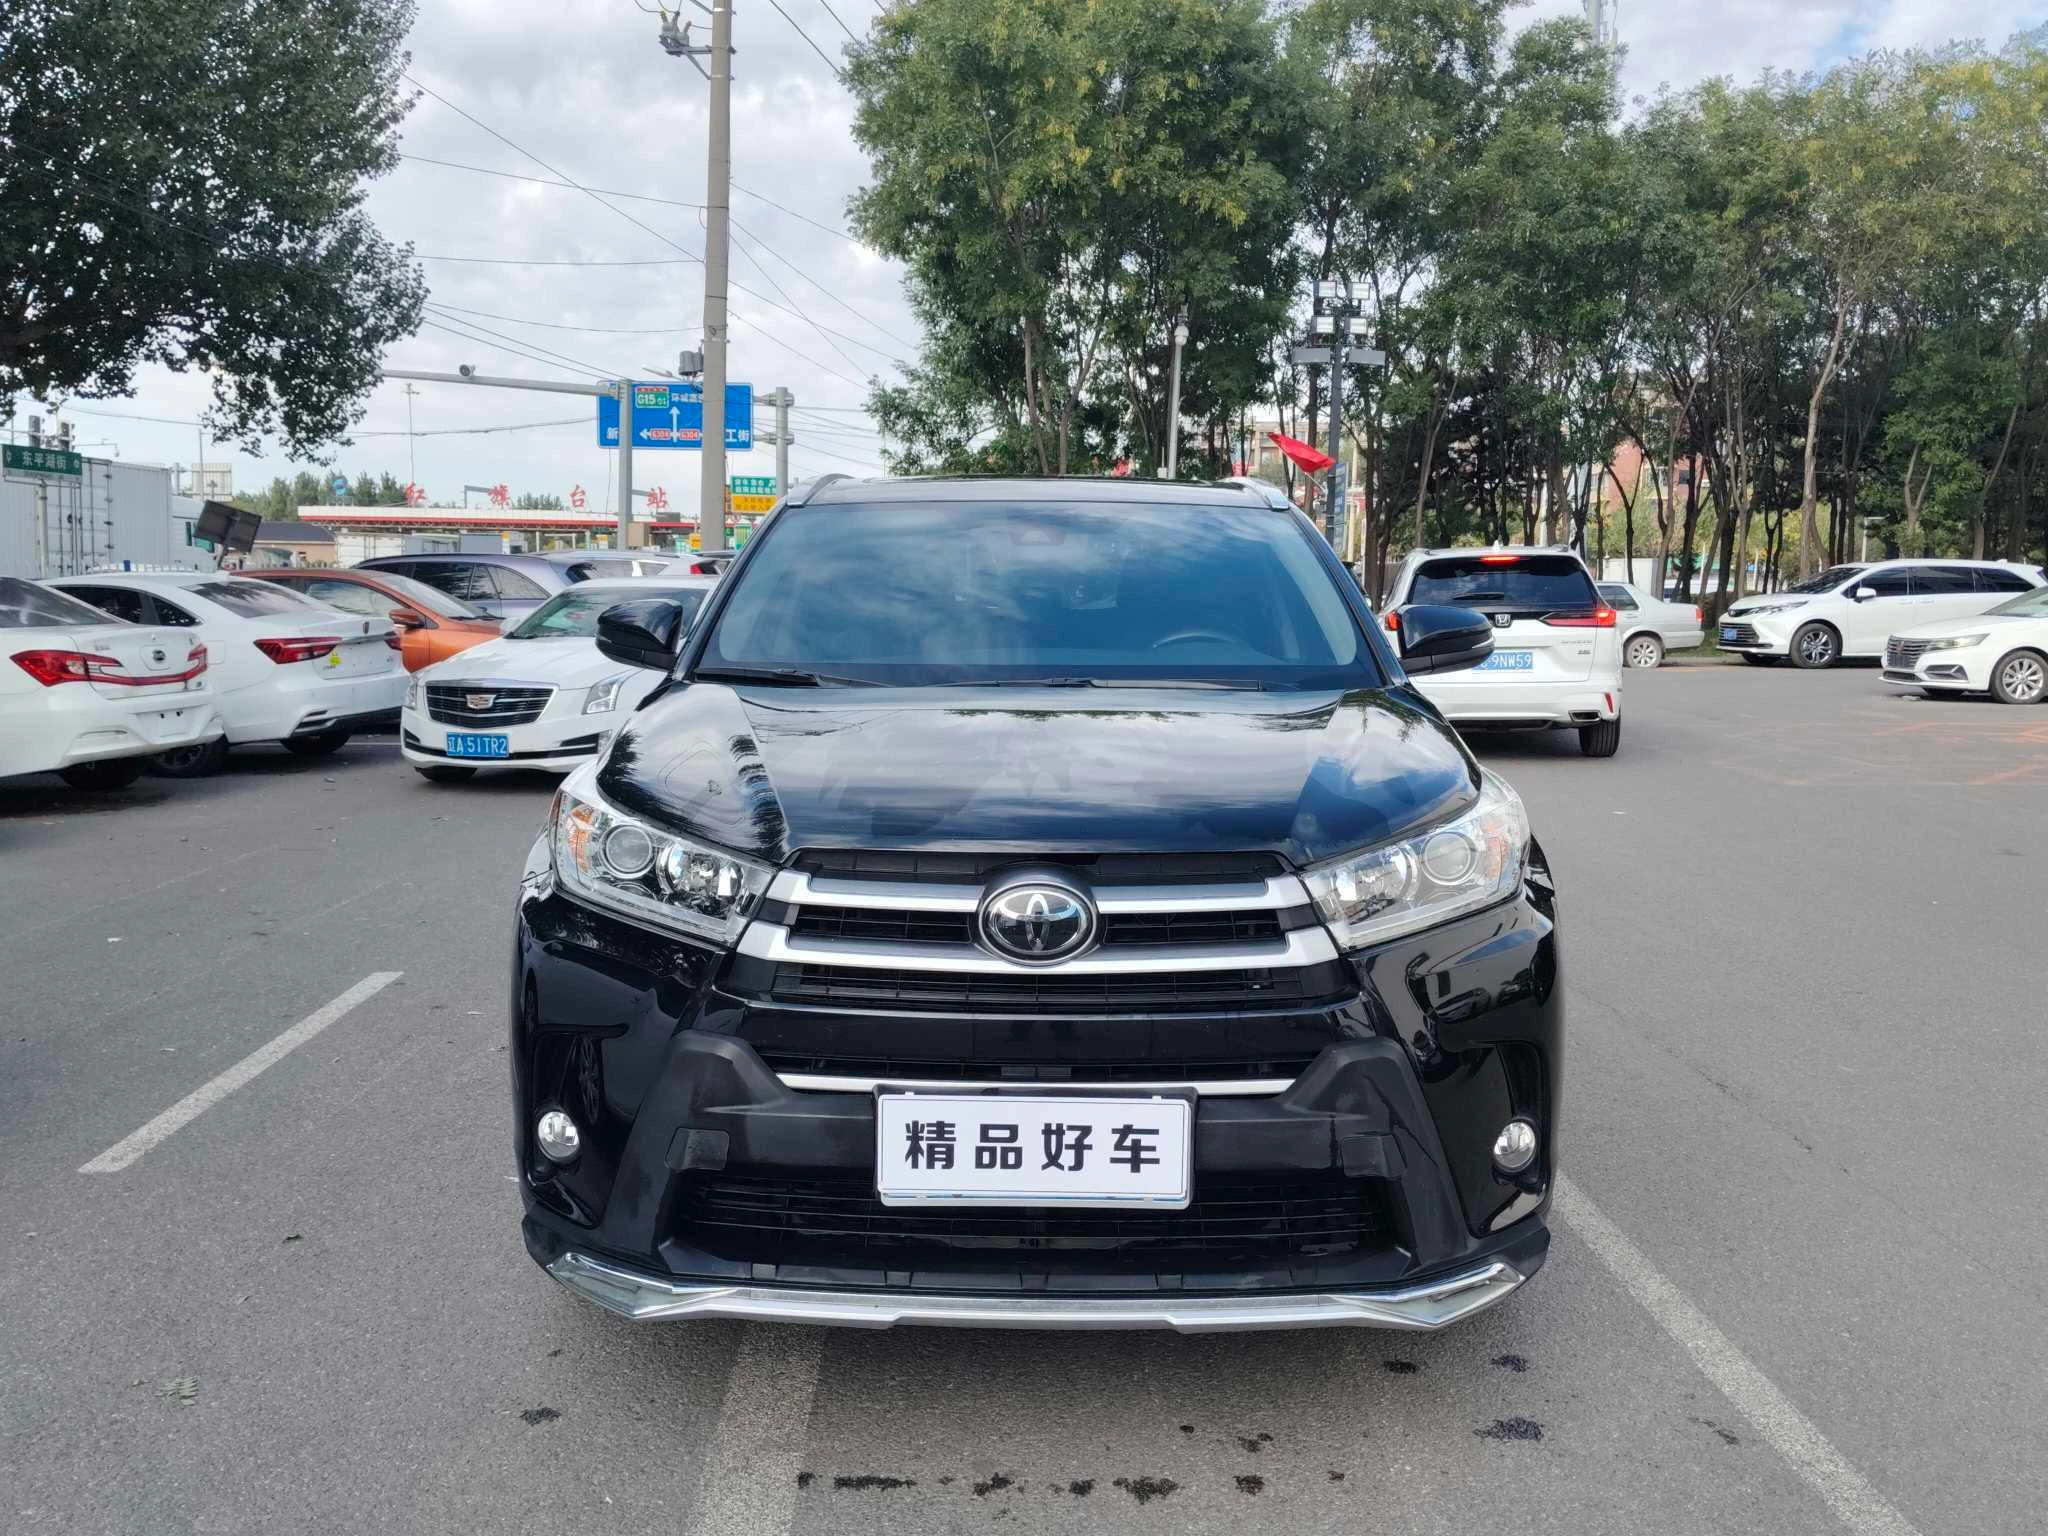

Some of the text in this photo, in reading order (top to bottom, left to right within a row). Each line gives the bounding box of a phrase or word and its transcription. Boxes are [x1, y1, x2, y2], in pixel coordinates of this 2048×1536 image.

[725, 428, 750, 442] 工街
[904, 1120, 1161, 1174] 精品好车
